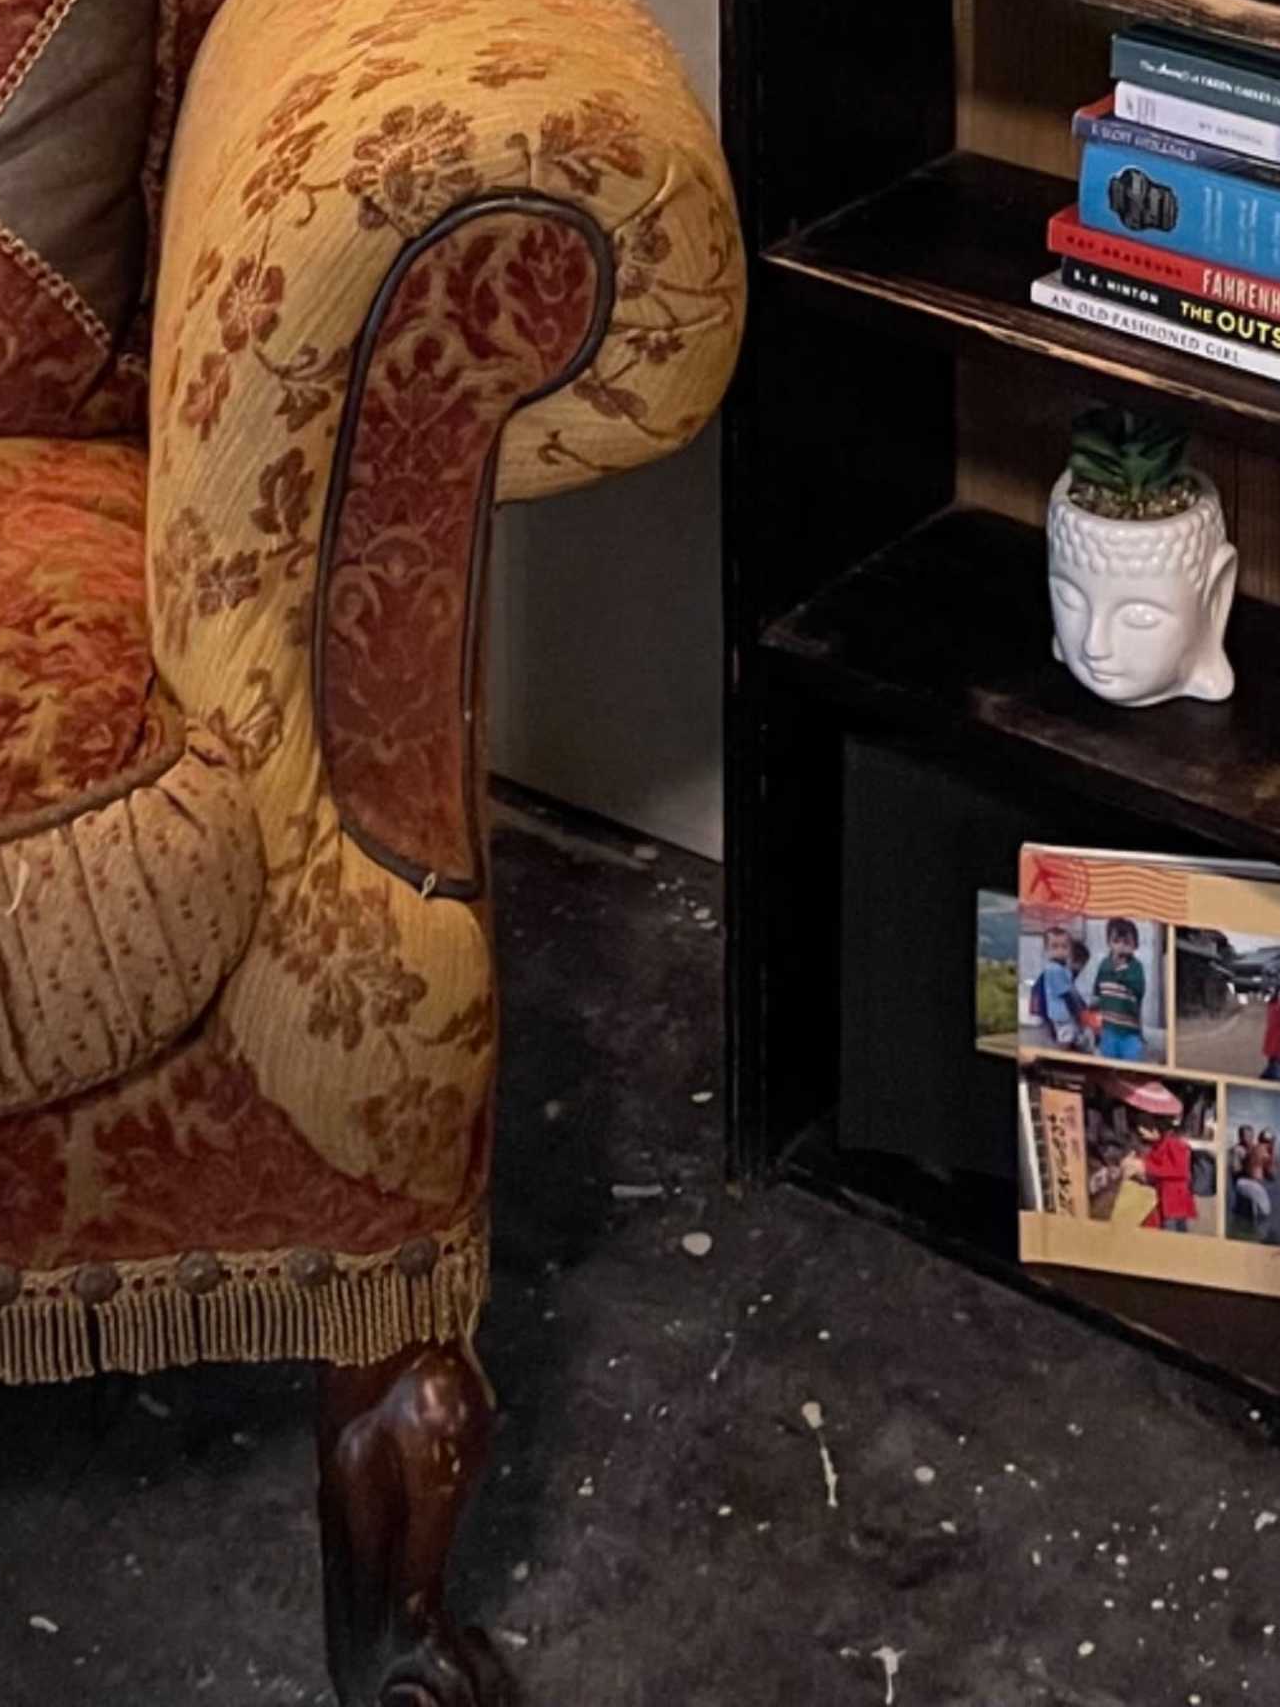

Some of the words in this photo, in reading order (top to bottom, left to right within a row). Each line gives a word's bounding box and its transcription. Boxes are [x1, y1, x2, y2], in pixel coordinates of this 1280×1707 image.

[1051, 294, 1071, 309] AN
[1205, 341, 1241, 364] GIRL
[1106, 280, 1160, 305] HINTON
[1179, 300, 1214, 325] THE
